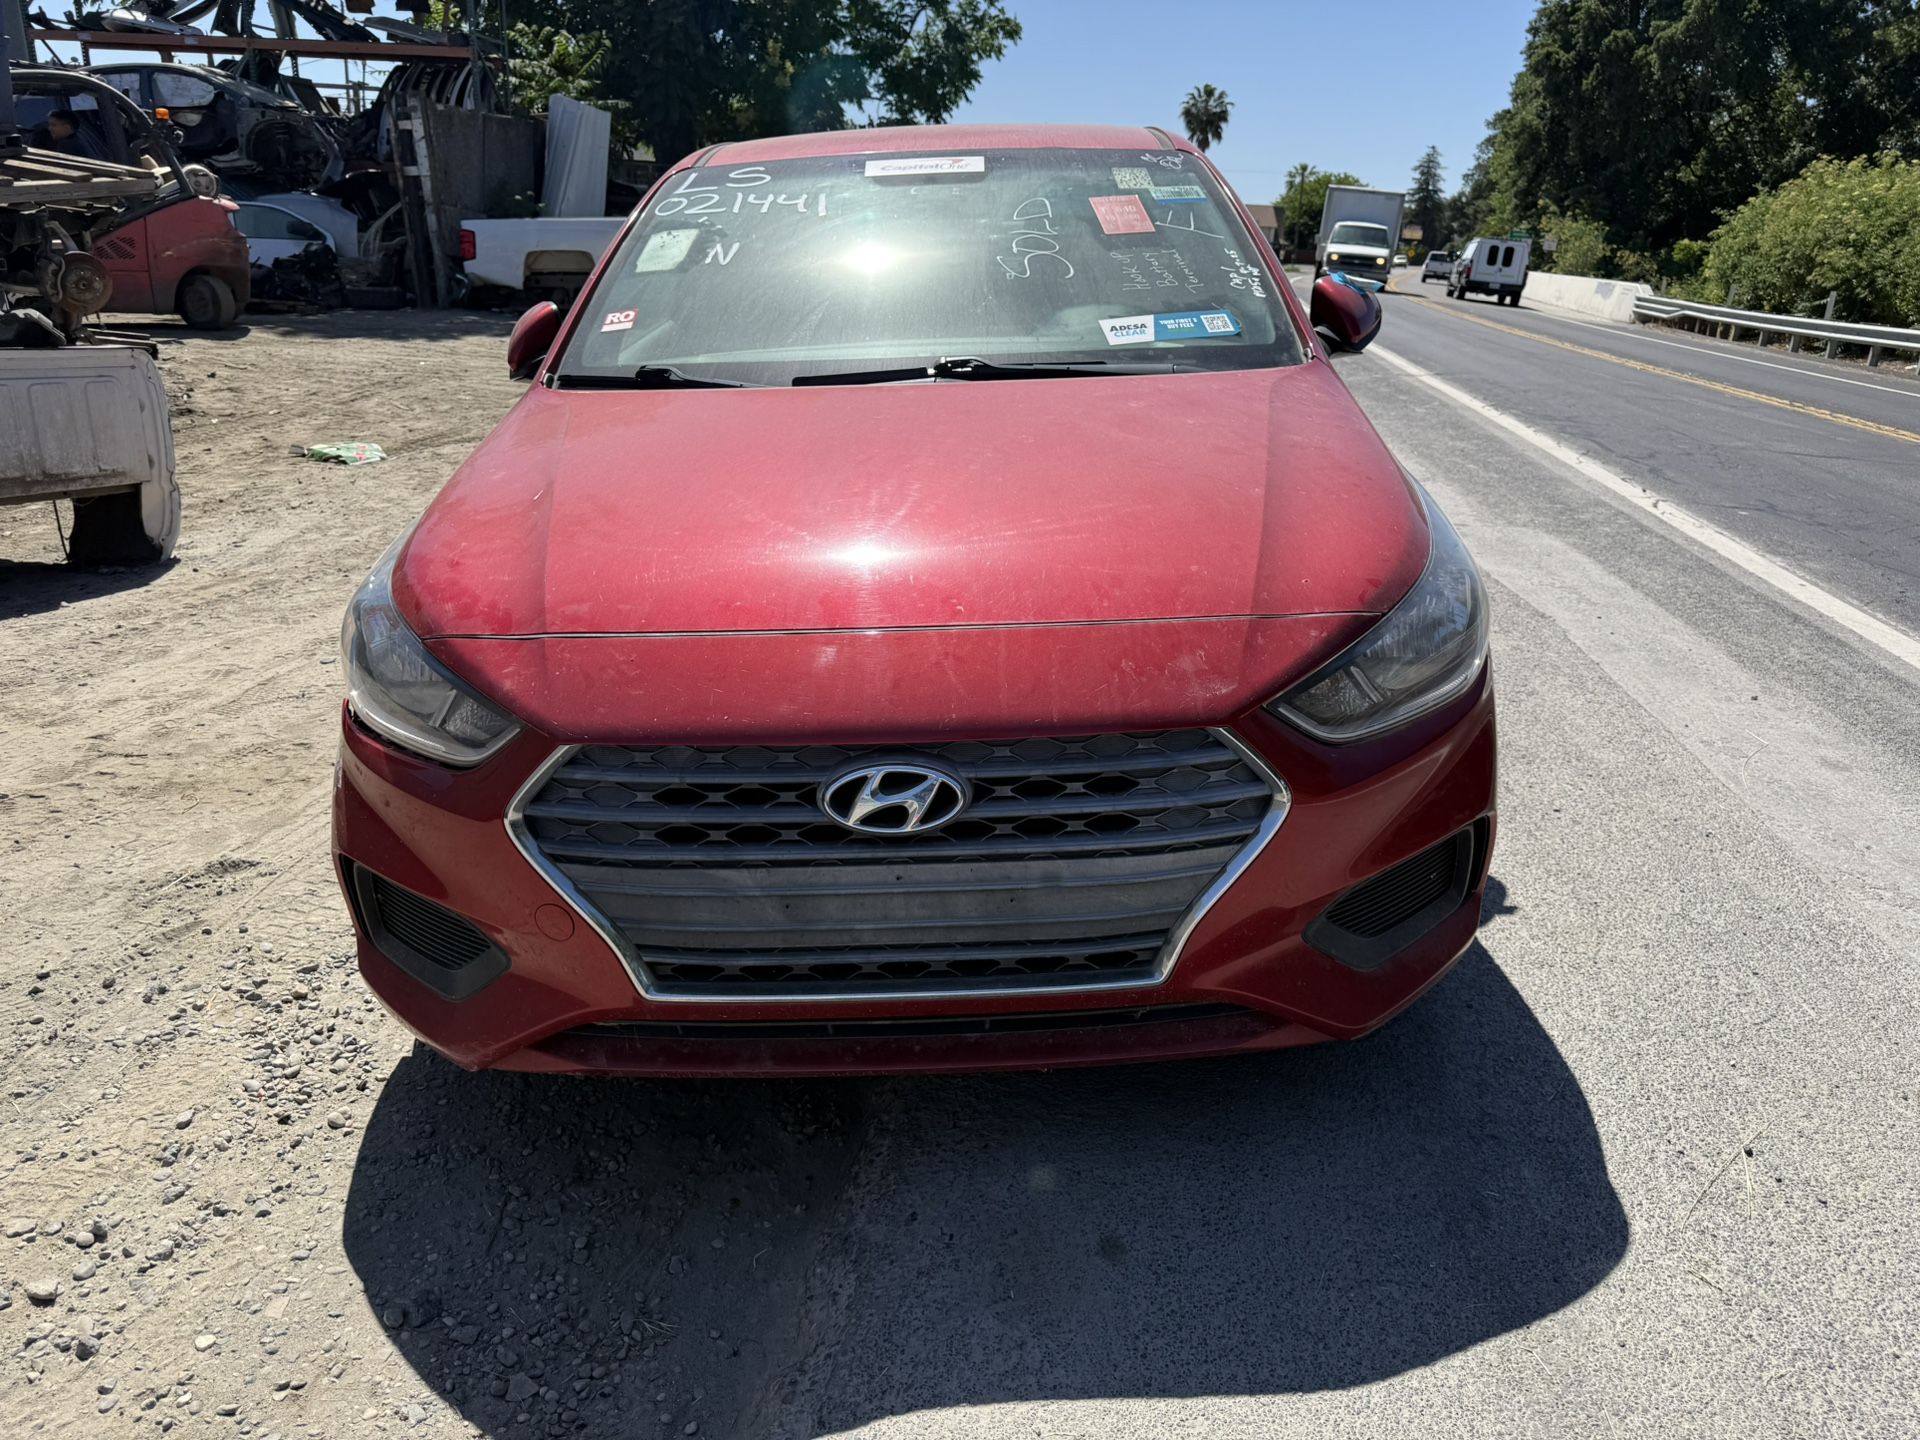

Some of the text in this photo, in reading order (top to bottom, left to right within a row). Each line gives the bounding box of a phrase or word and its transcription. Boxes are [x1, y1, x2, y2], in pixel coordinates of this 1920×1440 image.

[655, 192, 828, 217] 021441
[996, 197, 1075, 279] SOLD
[604, 310, 636, 324] RO
[1110, 323, 1148, 332] ADESA
[1114, 329, 1148, 337] CLEAR
